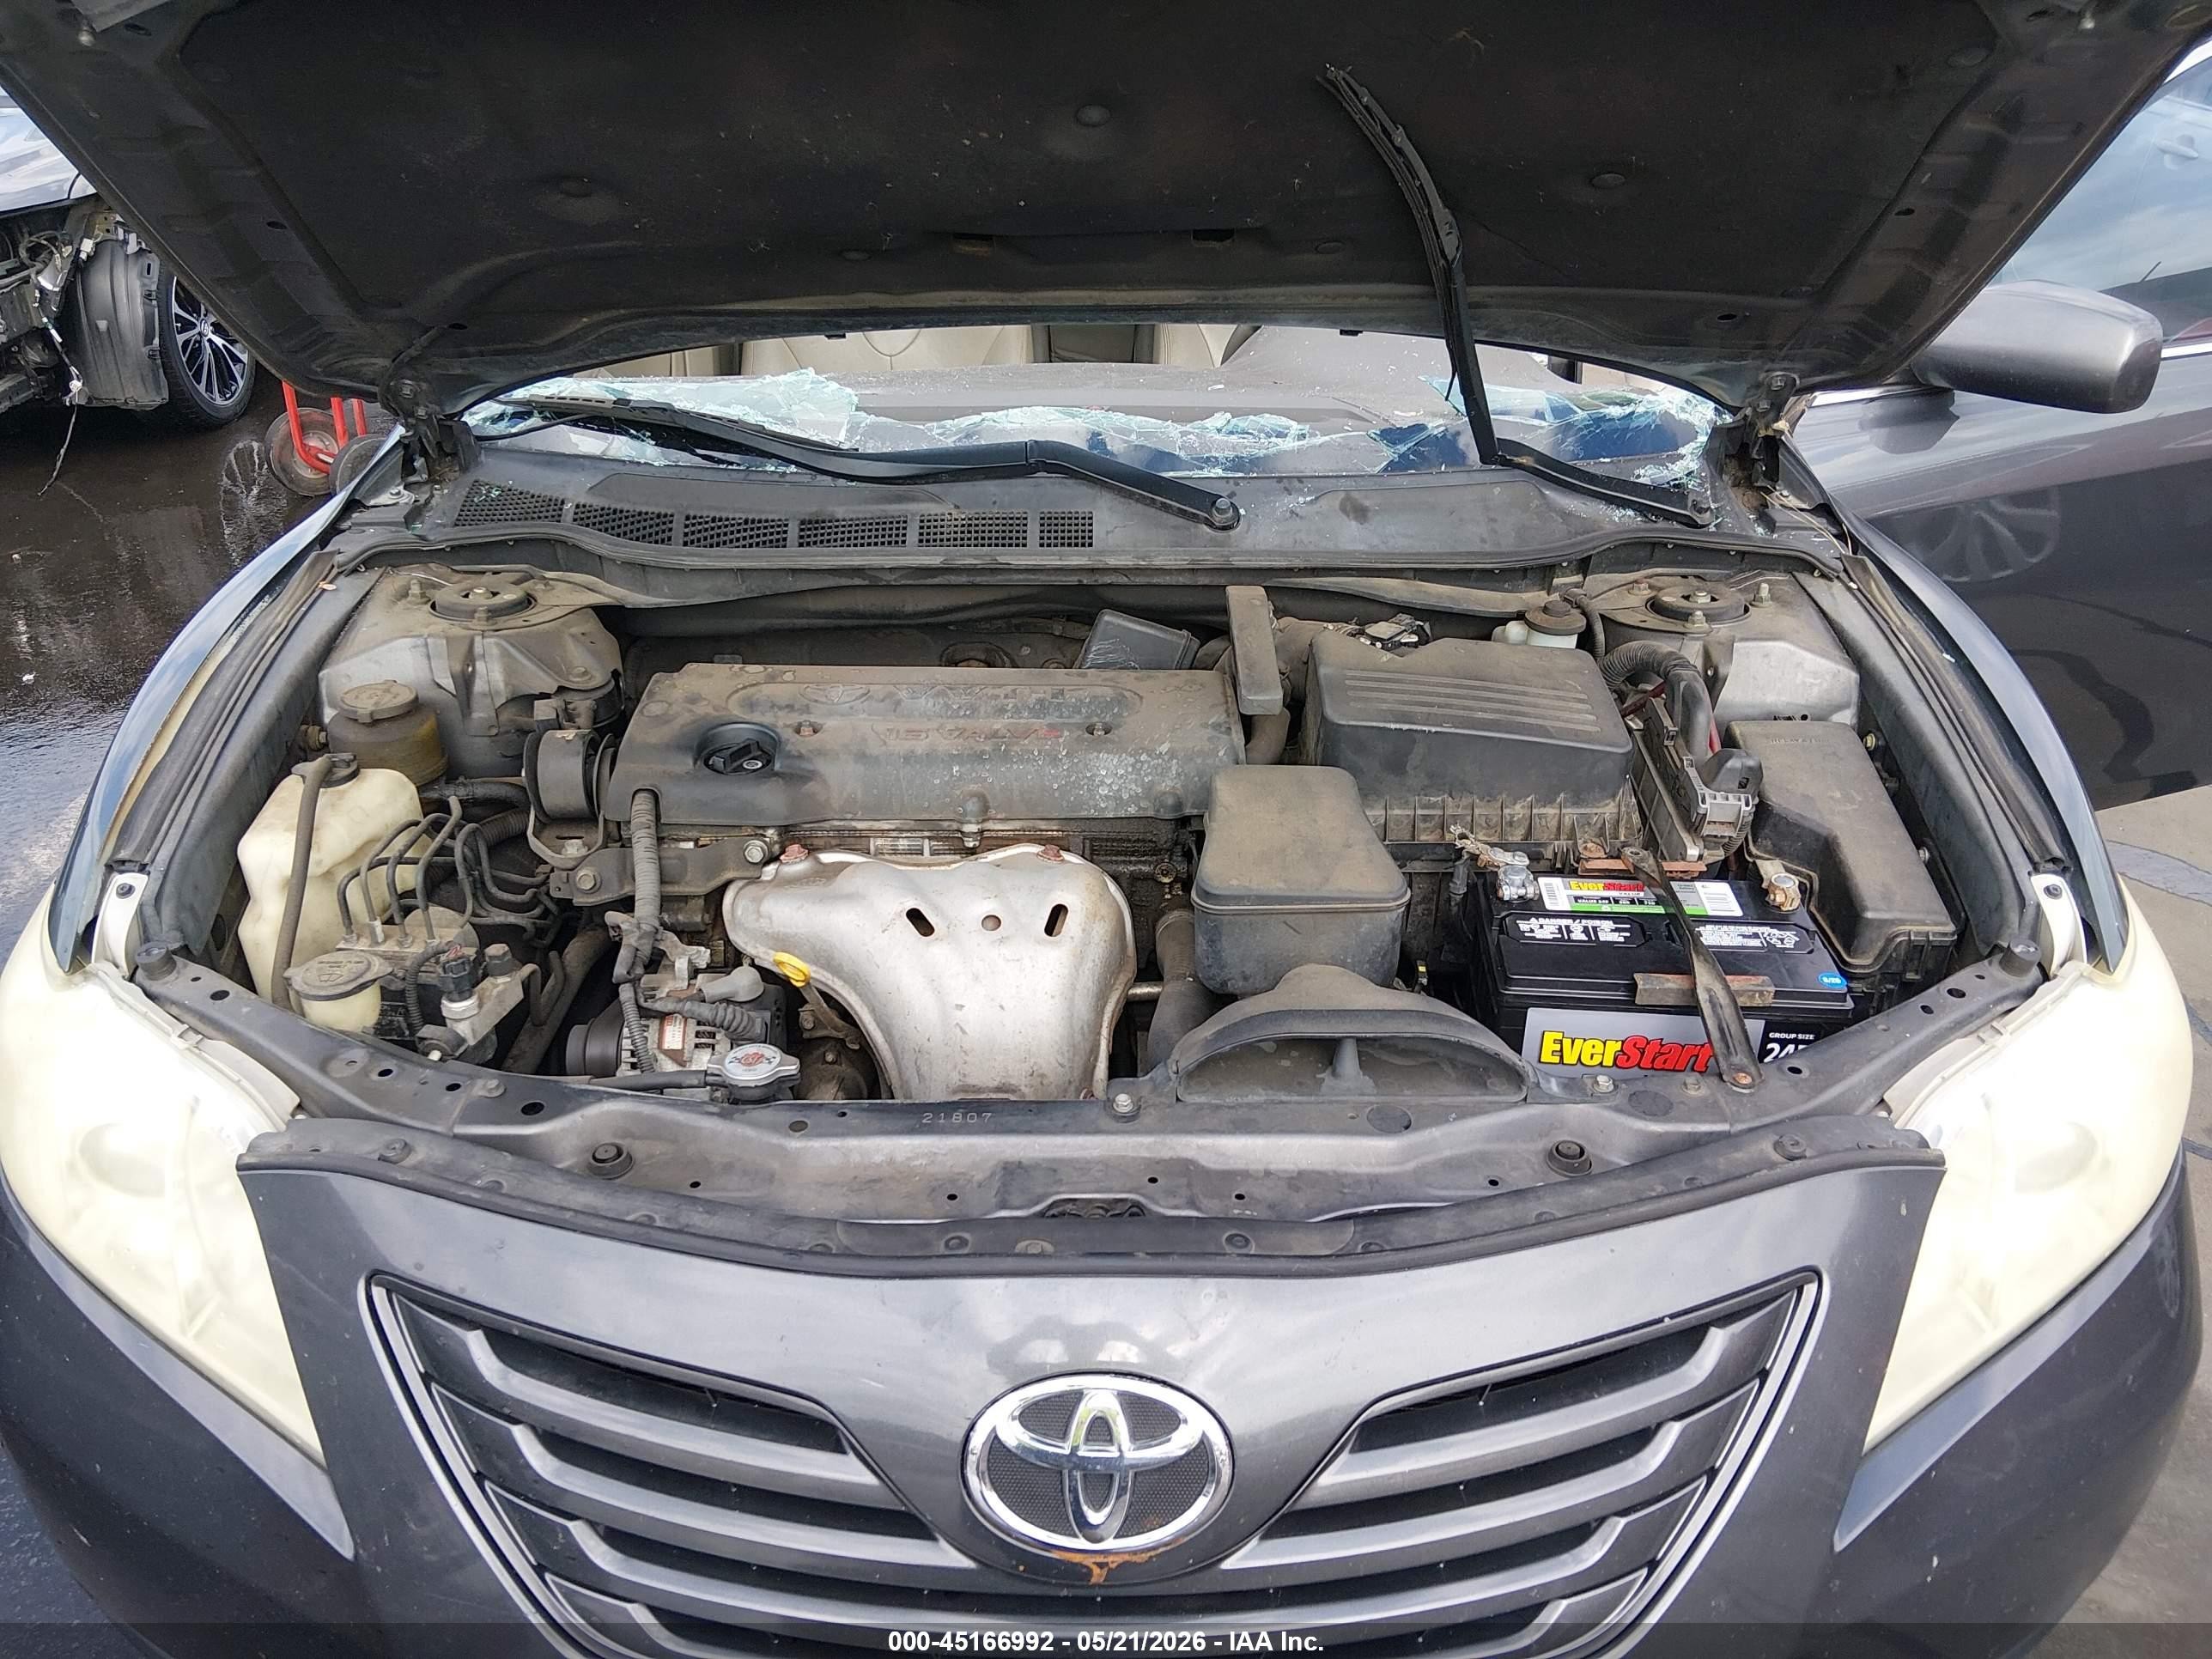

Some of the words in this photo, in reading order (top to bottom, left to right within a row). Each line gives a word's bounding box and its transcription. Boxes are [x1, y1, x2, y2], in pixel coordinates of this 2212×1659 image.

[1569, 880, 1646, 892] EverStart
[1540, 1030, 1715, 1073] EverStart
[921, 1112, 994, 1124] 21807
